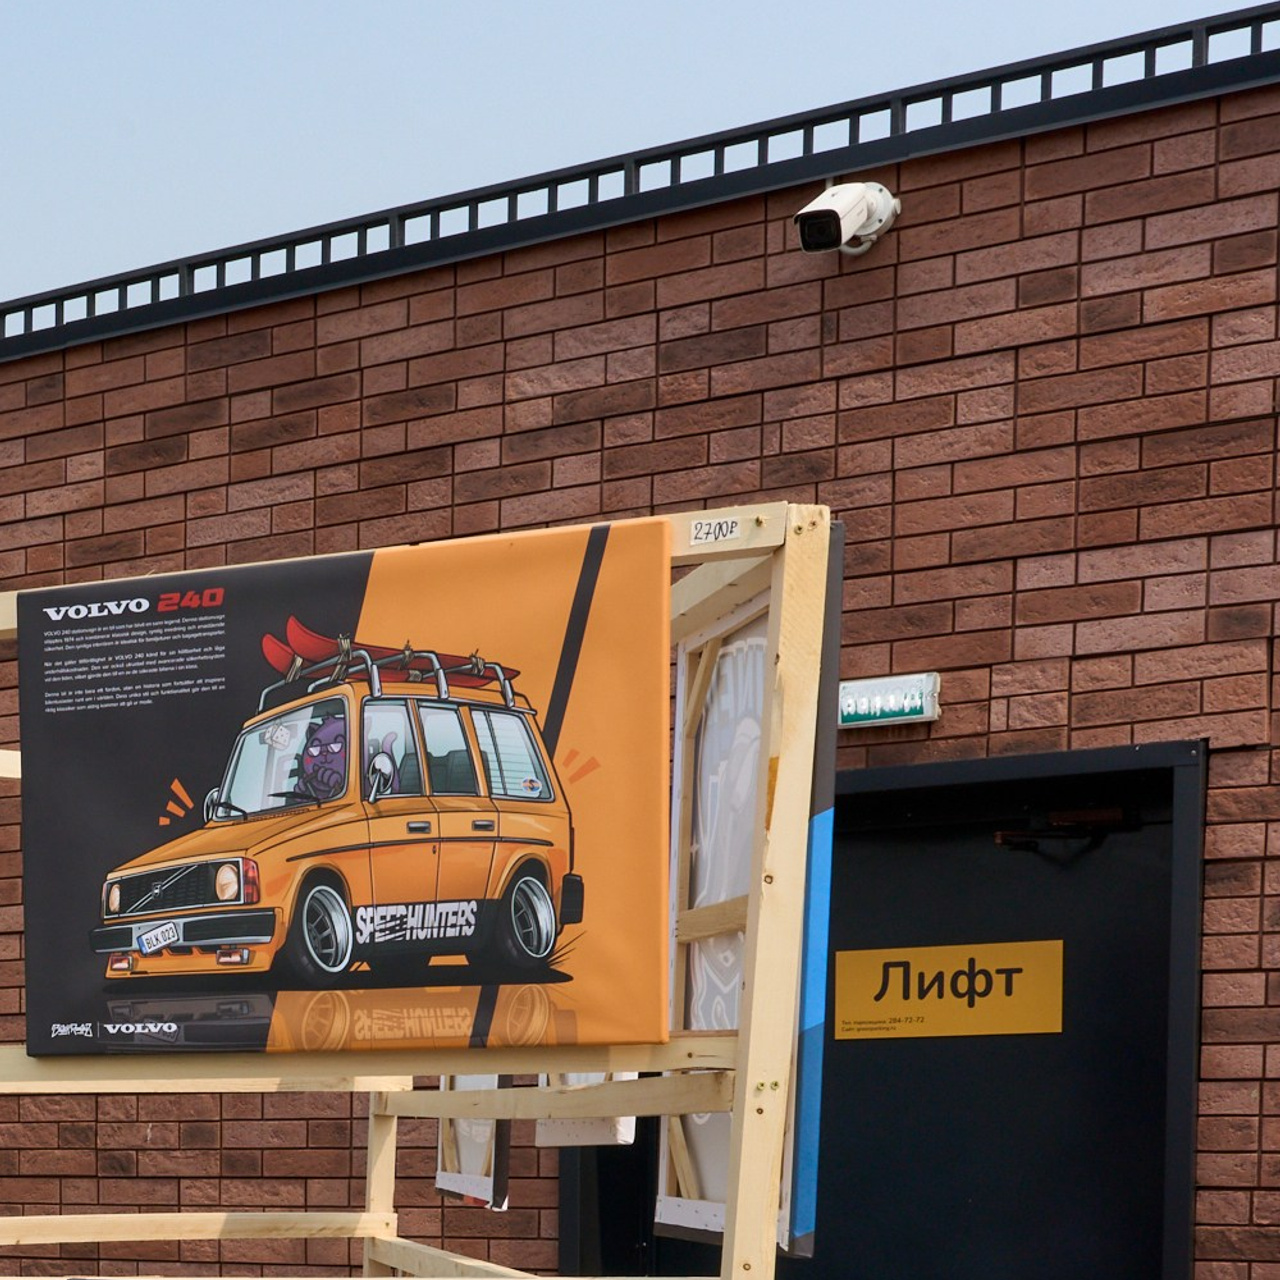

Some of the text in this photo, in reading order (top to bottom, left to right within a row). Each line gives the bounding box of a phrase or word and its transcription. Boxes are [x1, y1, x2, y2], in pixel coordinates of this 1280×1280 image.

[43, 587, 225, 621] VOLVO 240
[874, 957, 1023, 1008] Лифт
[104, 1022, 178, 1034] VOLVO
